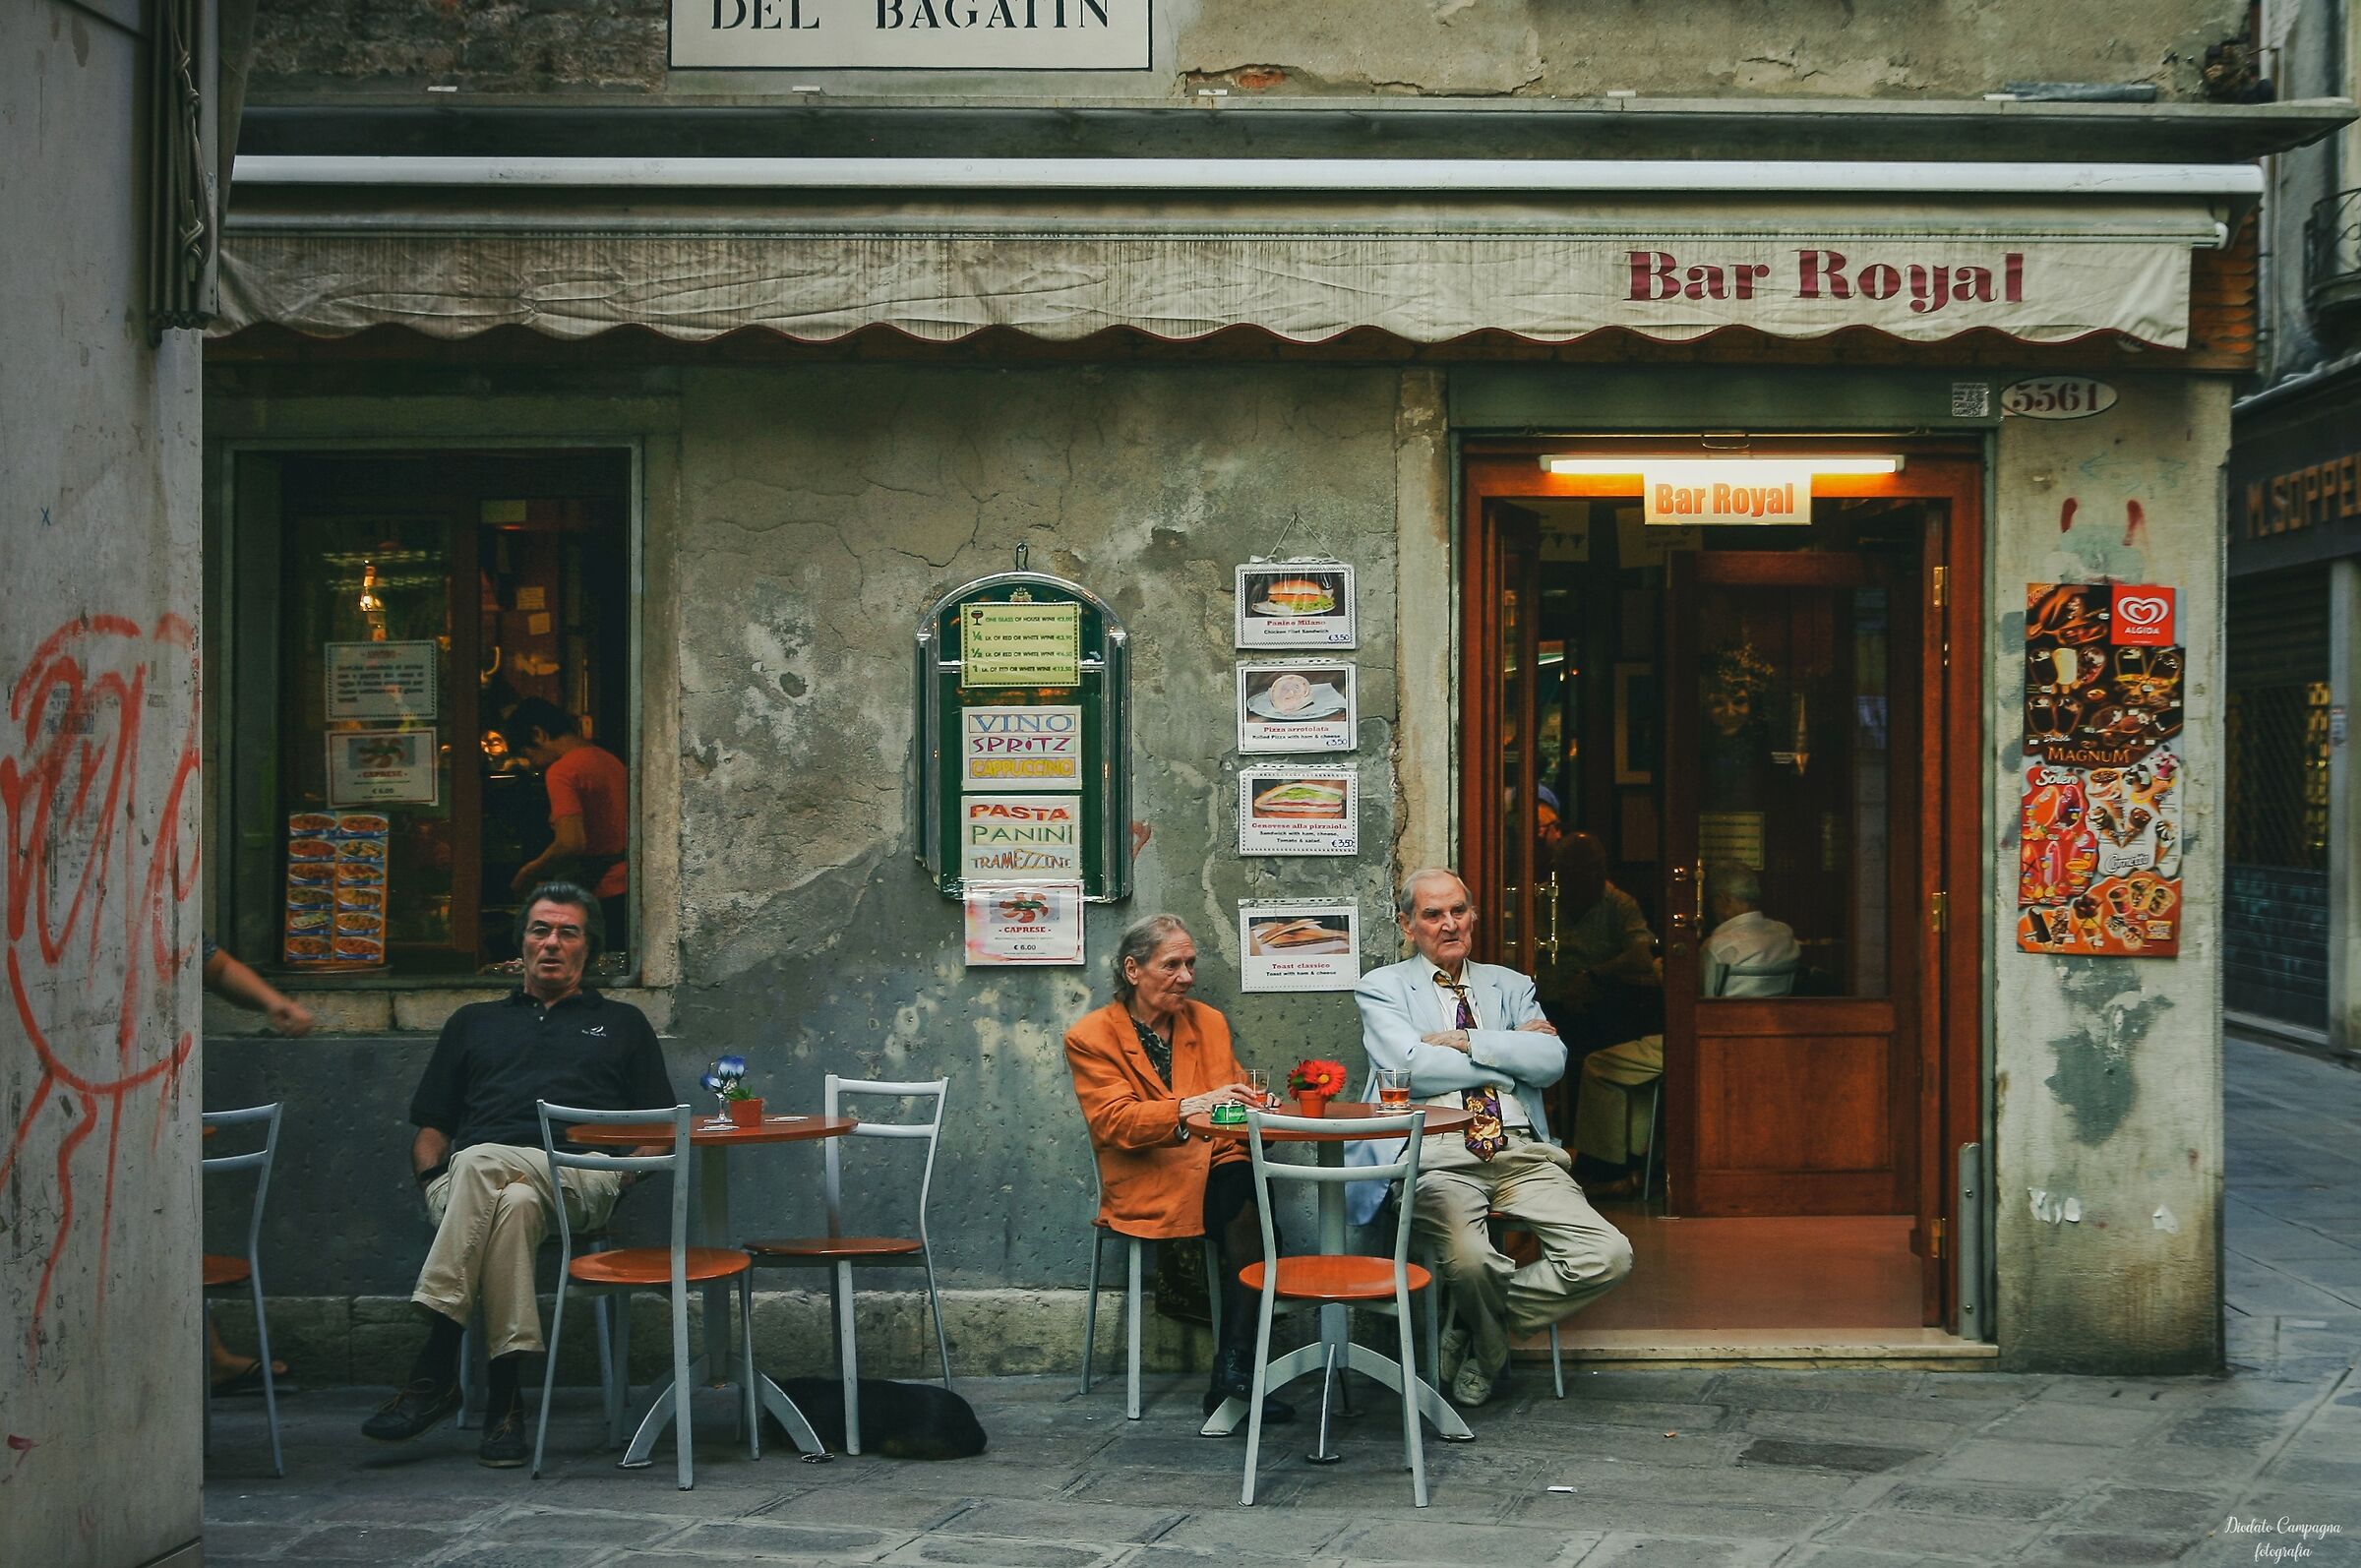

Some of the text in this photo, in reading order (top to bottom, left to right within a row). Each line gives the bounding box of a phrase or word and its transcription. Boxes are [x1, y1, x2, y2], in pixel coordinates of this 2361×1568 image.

[710, 0, 1109, 30] DEL BAGATIN
[1623, 249, 2024, 313] Bar Royal
[2012, 383, 2097, 411] 5561
[1655, 482, 1793, 517] Bar Royal
[972, 714, 1072, 732] VINO
[2047, 746, 2131, 763] MAGNUM
[971, 759, 1073, 777] CAPPUCCINO
[970, 805, 1069, 821] PASTA
[972, 824, 1072, 845] PANINI
